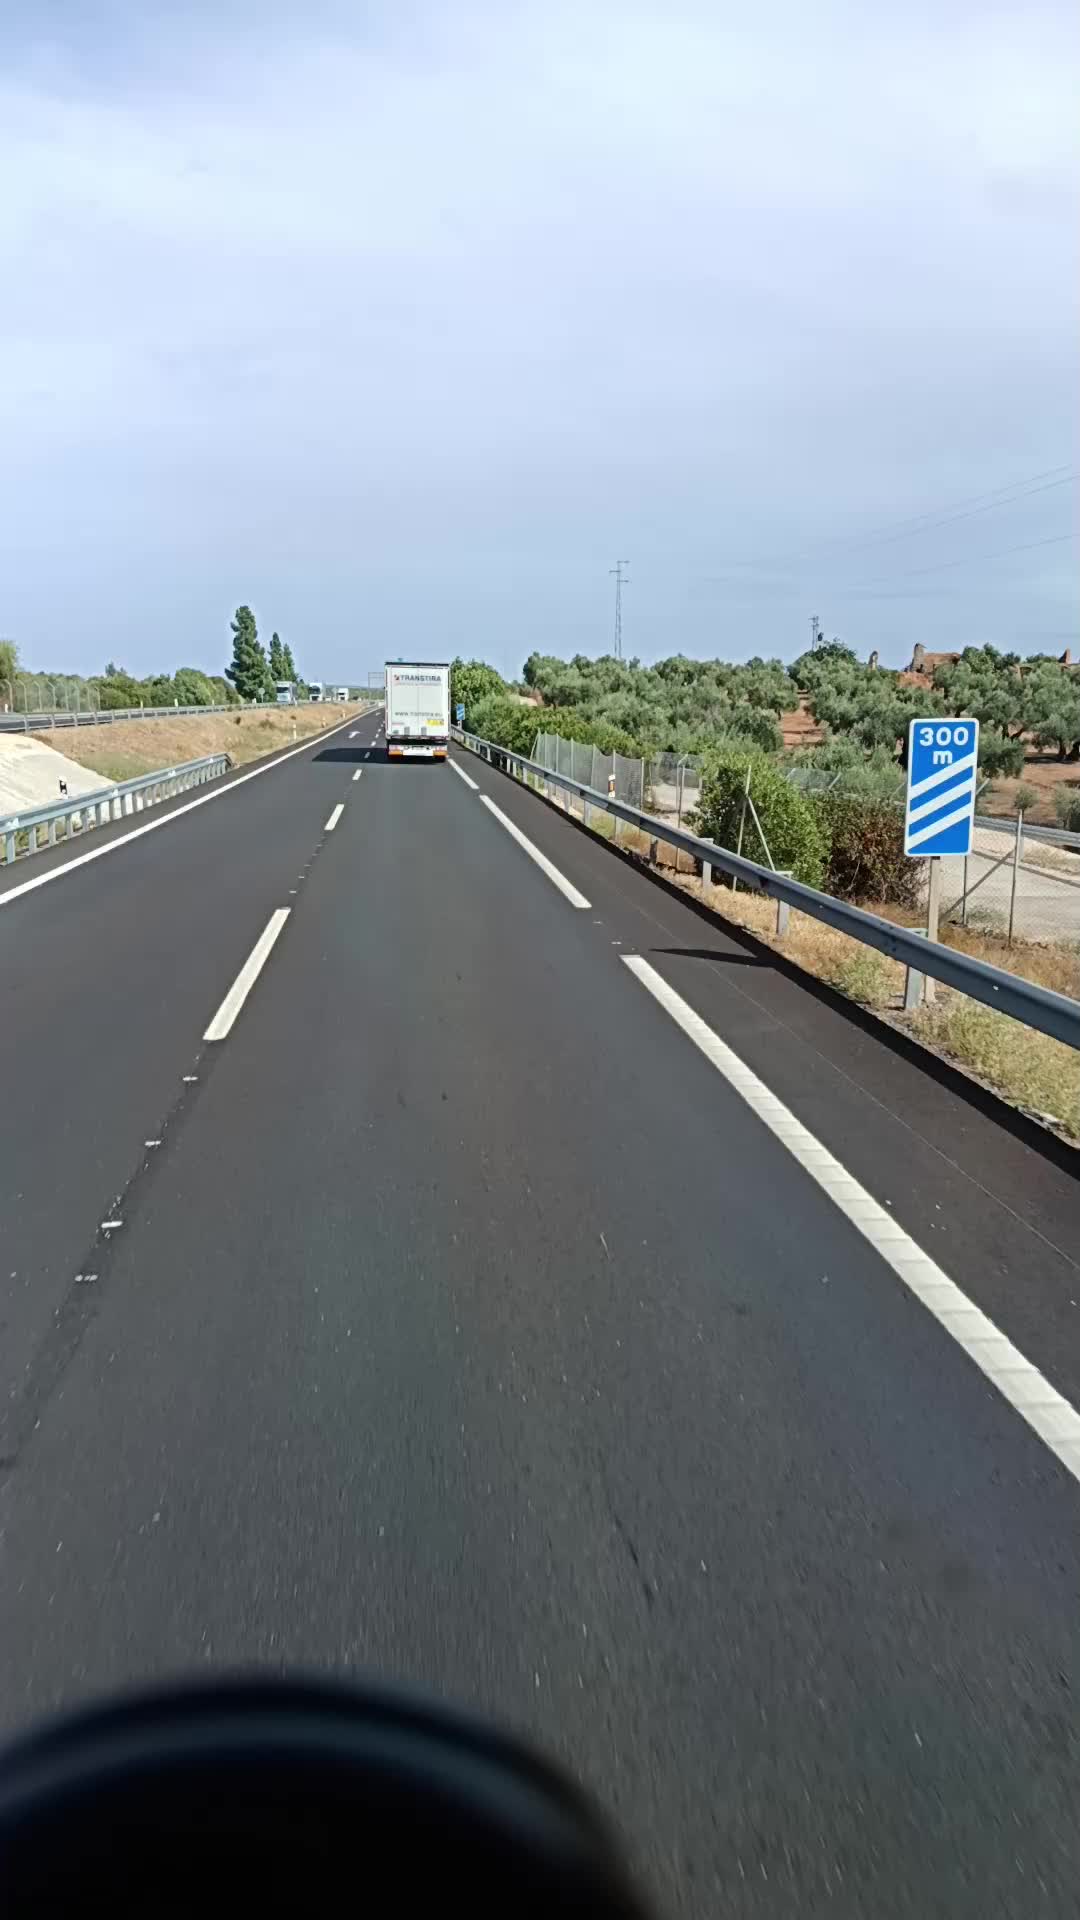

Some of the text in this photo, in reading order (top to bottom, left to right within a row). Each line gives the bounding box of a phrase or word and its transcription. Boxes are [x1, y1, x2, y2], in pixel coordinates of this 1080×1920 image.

[401, 674, 442, 682] TRANSTIRA
[919, 726, 969, 747] 300
[933, 750, 953, 765] m
